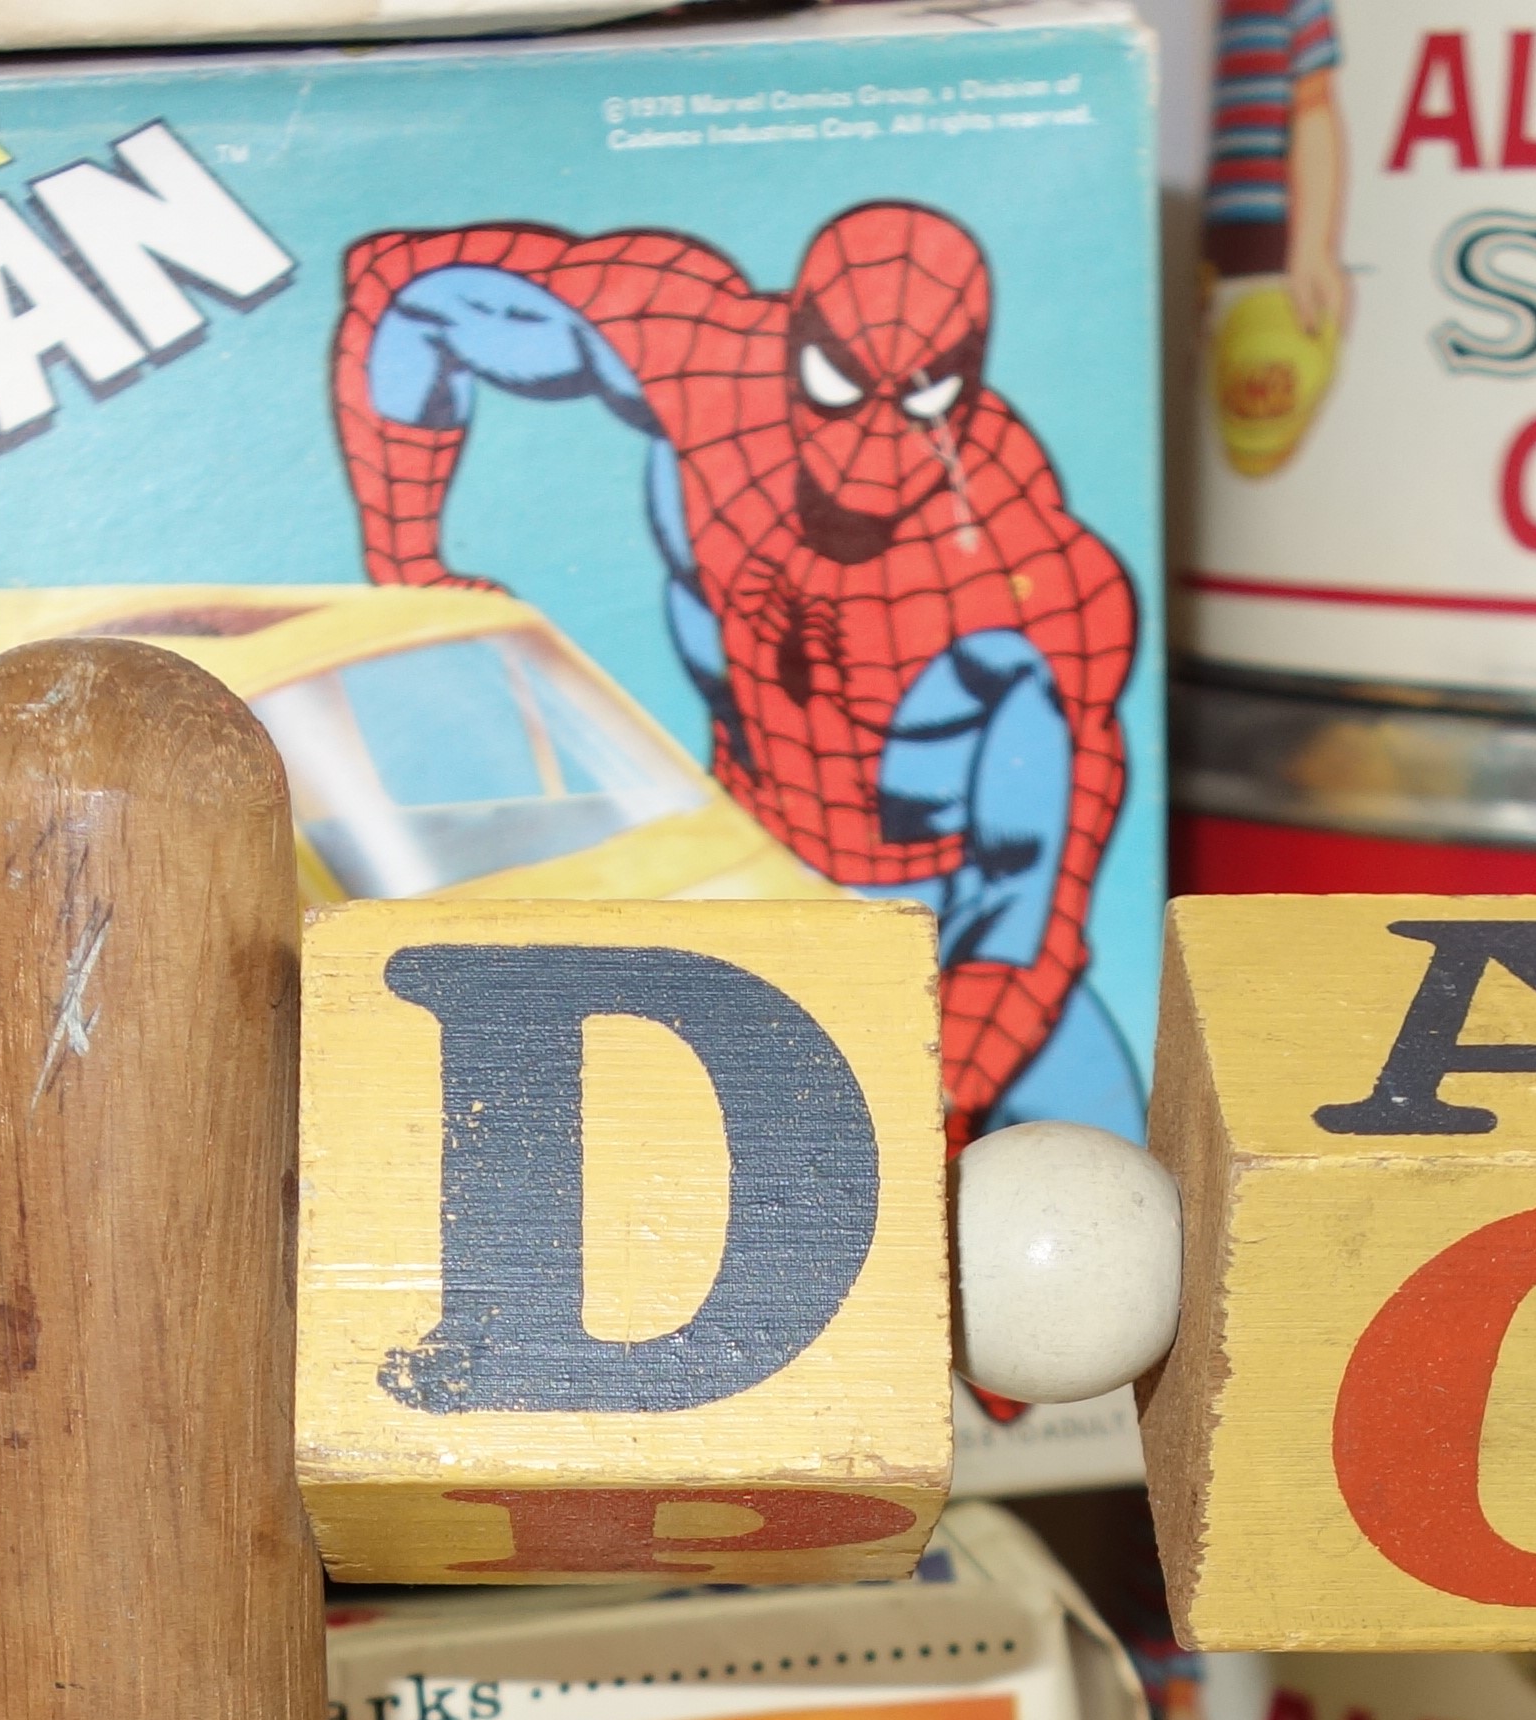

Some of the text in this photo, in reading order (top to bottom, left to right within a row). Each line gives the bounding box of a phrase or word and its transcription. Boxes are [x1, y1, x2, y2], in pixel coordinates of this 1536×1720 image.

[690, 91, 766, 114] Marvel
[769, 89, 853, 111] Comics
[376, 942, 880, 1415] D
[442, 1488, 917, 1574] P
